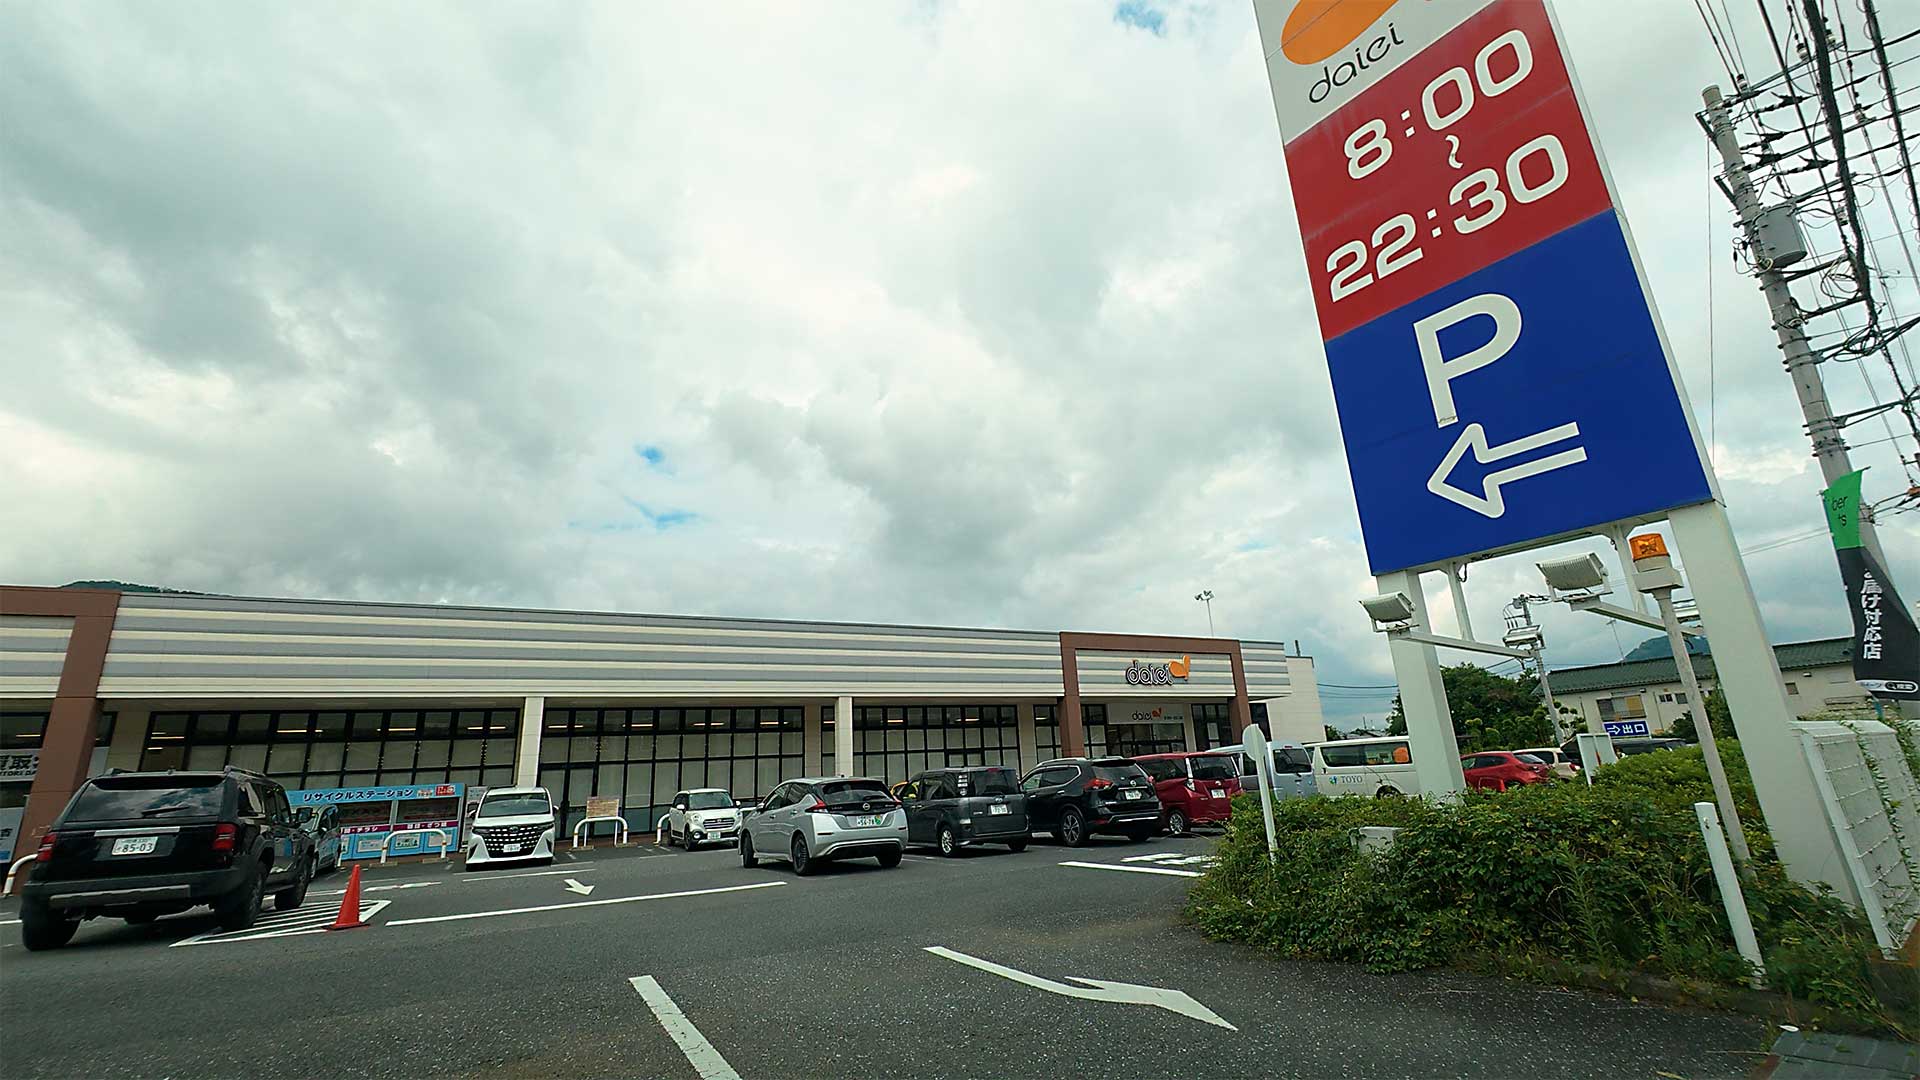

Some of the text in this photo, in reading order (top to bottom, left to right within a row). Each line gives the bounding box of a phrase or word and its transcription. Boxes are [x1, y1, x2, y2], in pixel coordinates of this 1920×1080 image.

[1309, 22, 1404, 103] daiei
[1344, 29, 1534, 180] 8:00
[1326, 134, 1569, 303] 22:30
[1413, 293, 1523, 428] P
[1832, 496, 1848, 511] ber
[1126, 659, 1173, 686] daiei
[1622, 723, 1646, 734] 出口
[1341, 775, 1363, 784] TOYO
[303, 788, 414, 802] リサイクルステーション
[122, 842, 153, 853] 85-03
